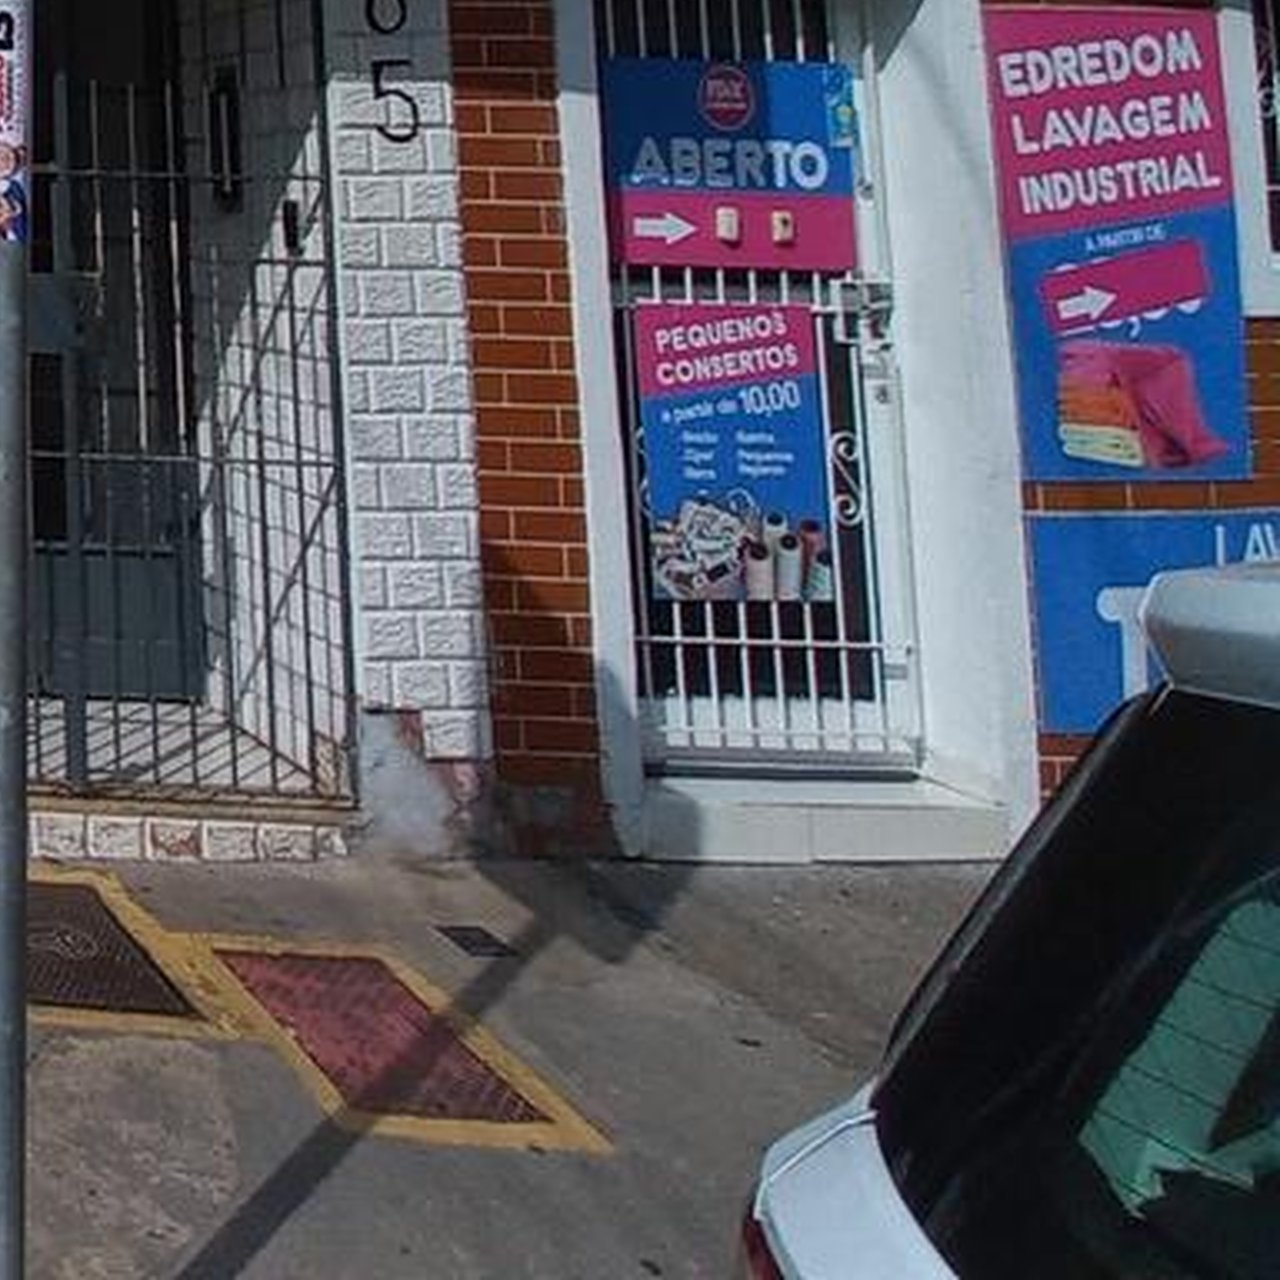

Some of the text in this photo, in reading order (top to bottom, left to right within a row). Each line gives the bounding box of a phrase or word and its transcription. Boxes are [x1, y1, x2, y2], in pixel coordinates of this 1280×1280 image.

[998, 29, 1203, 98] EDREDOM
[1011, 90, 1212, 154] LAVAGEM
[631, 136, 829, 190] ABERTO
[1018, 151, 1222, 215] INDUSTRIAL
[654, 311, 788, 354] PEQUENOS
[656, 342, 800, 387] CONSERTOS
[739, 380, 802, 418] 10,00
